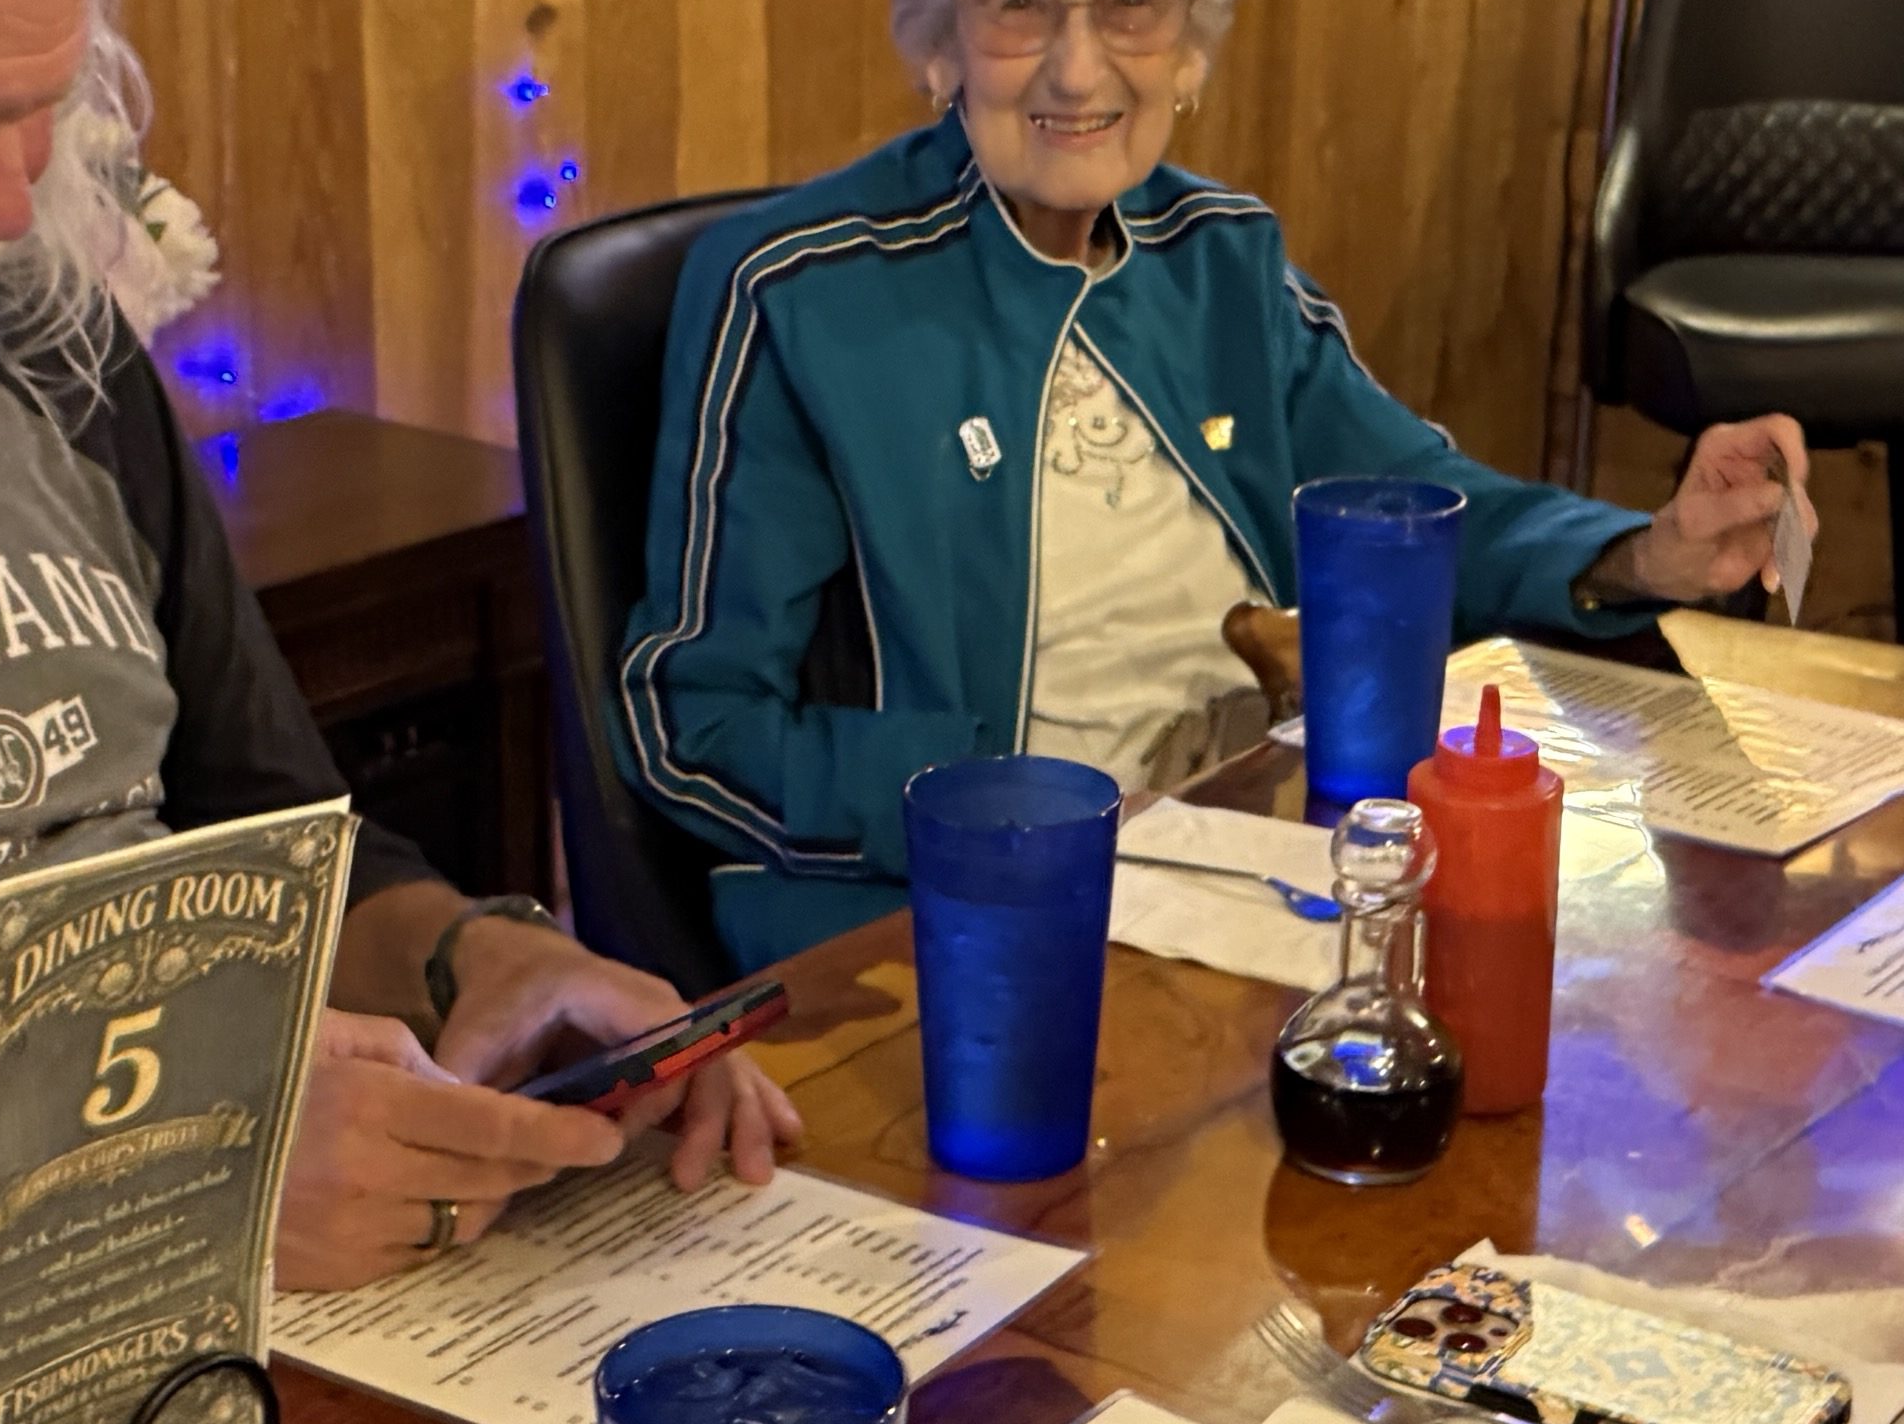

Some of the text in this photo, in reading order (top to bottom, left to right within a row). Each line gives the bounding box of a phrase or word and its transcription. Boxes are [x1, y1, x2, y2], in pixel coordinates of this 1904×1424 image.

[42, 706, 92, 759] 49
[11, 872, 285, 1005] DINING ROOM
[81, 1005, 165, 1128] 5
